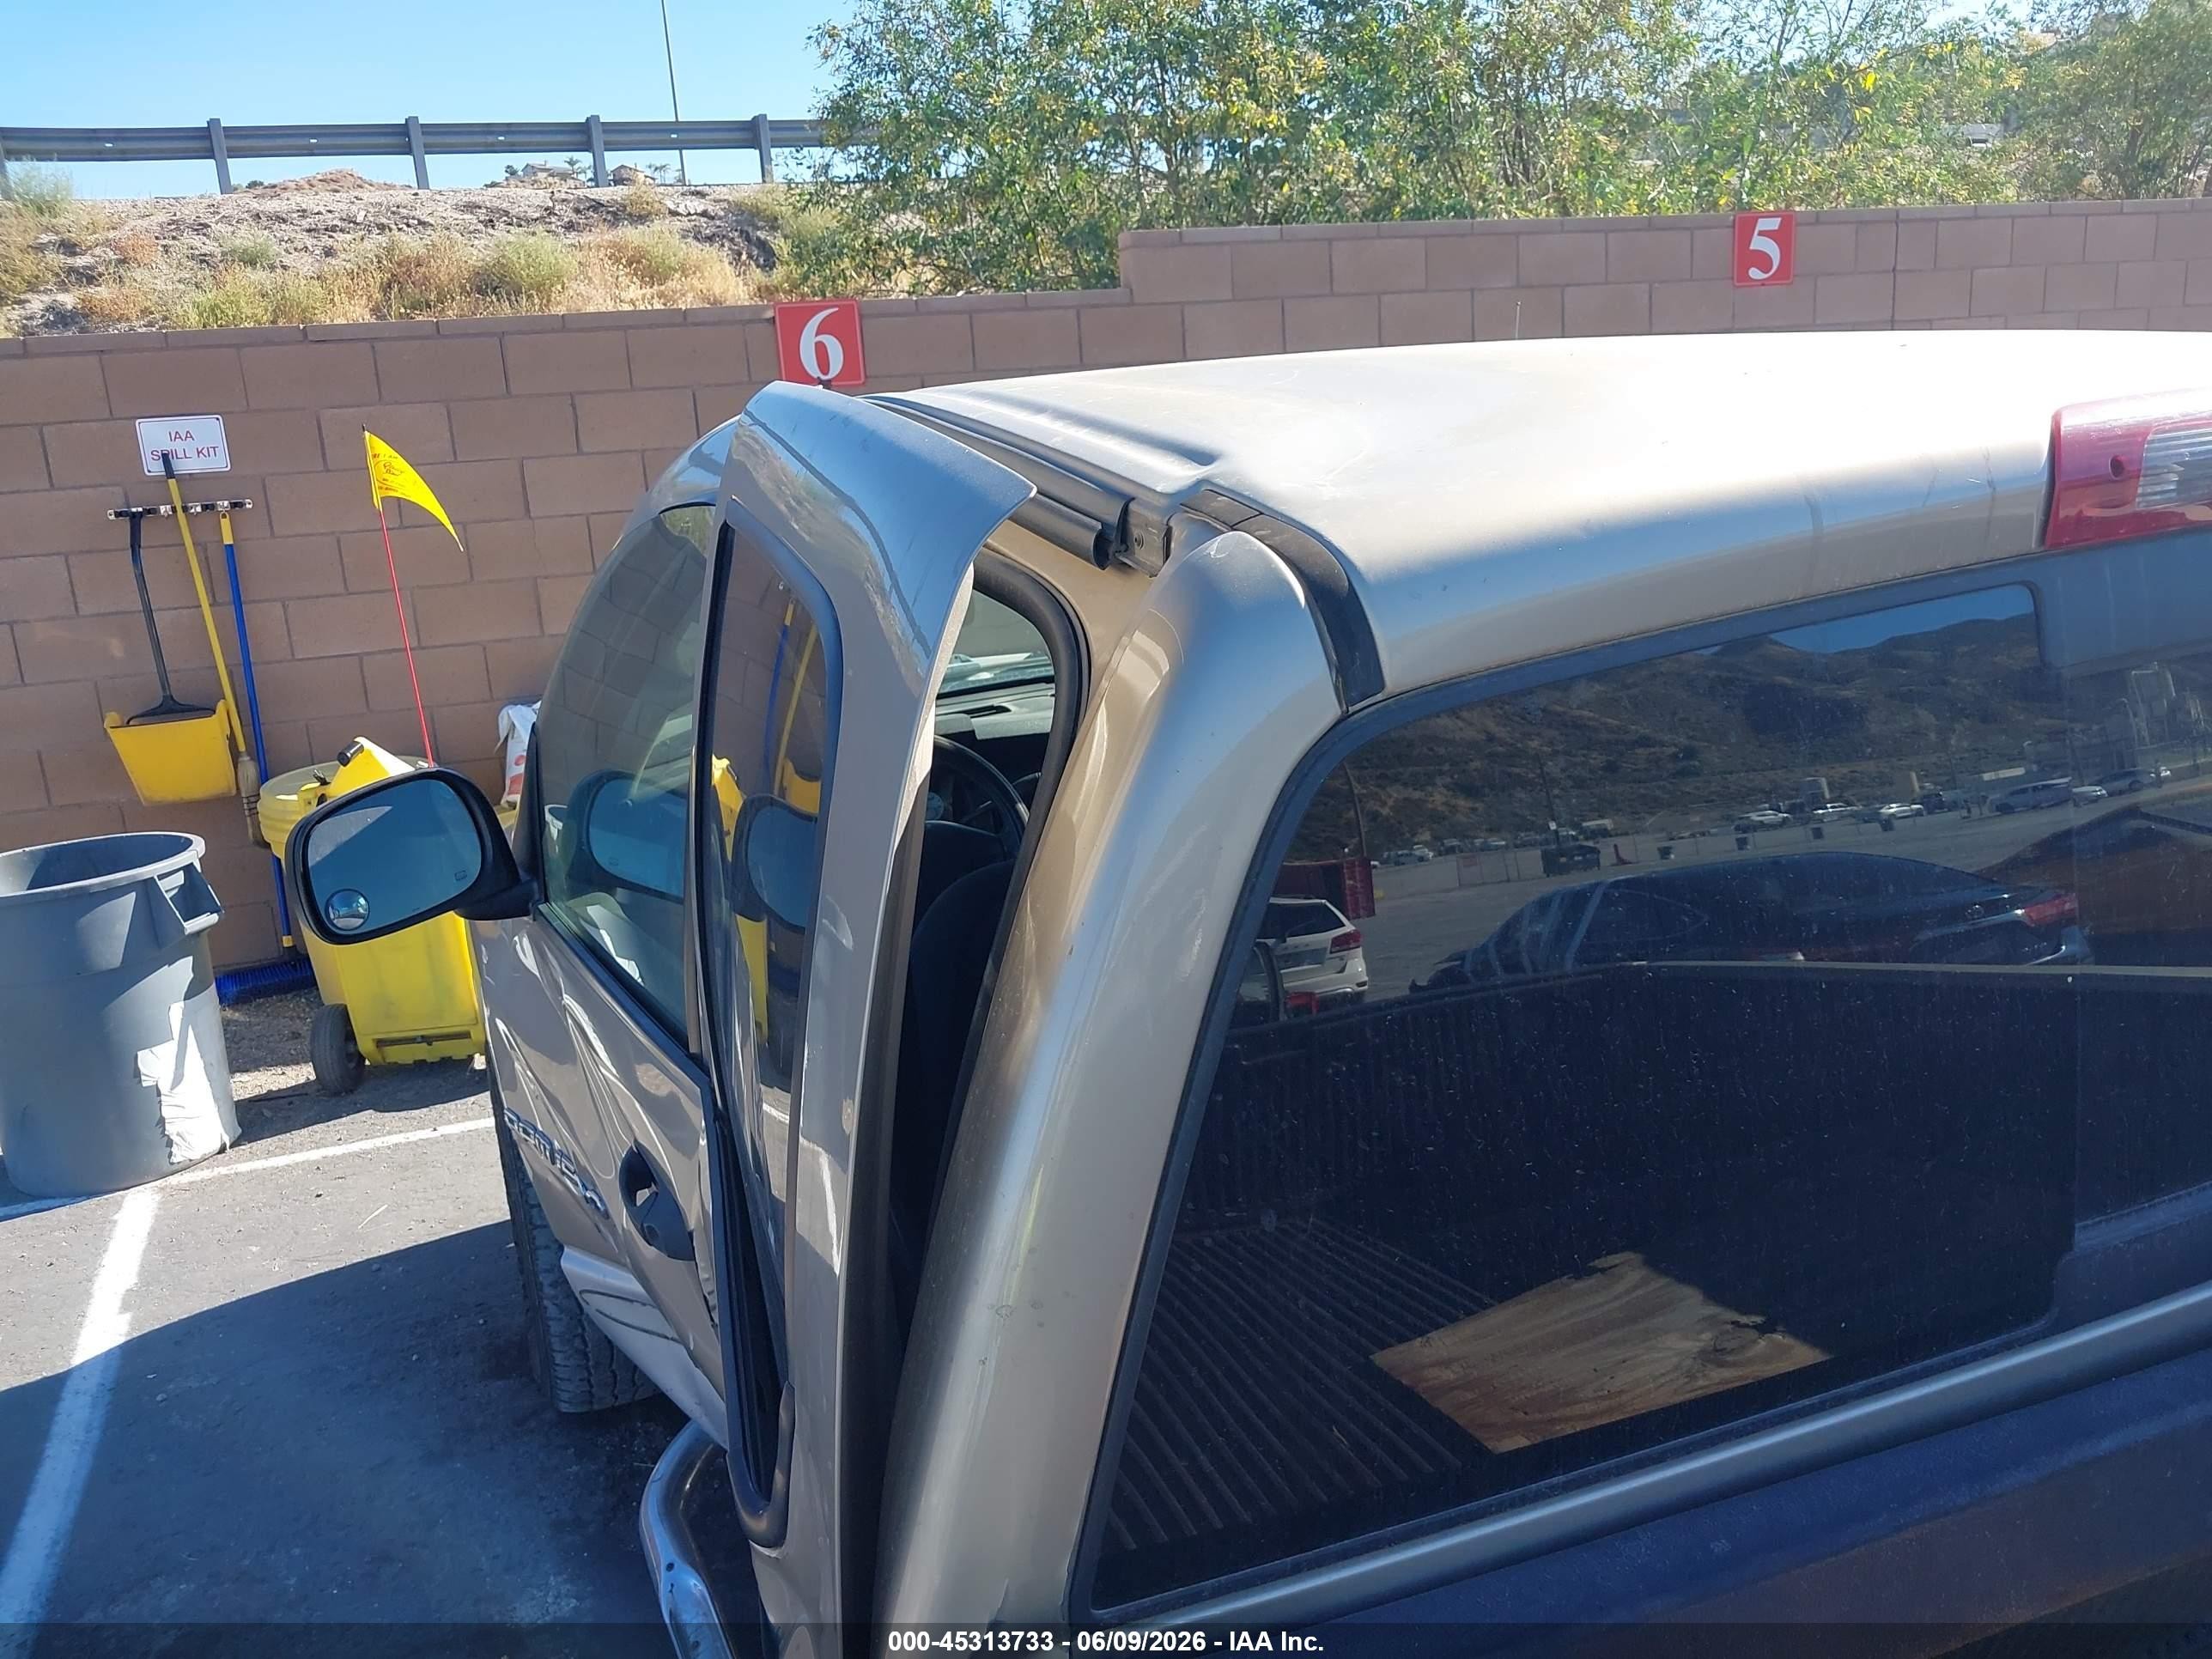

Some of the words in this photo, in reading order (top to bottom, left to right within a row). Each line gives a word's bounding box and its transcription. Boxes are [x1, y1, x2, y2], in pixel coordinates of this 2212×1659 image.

[1748, 217, 1782, 280] 5
[799, 307, 844, 380] 6
[168, 430, 195, 442] IAA
[196, 446, 220, 459] KIT
